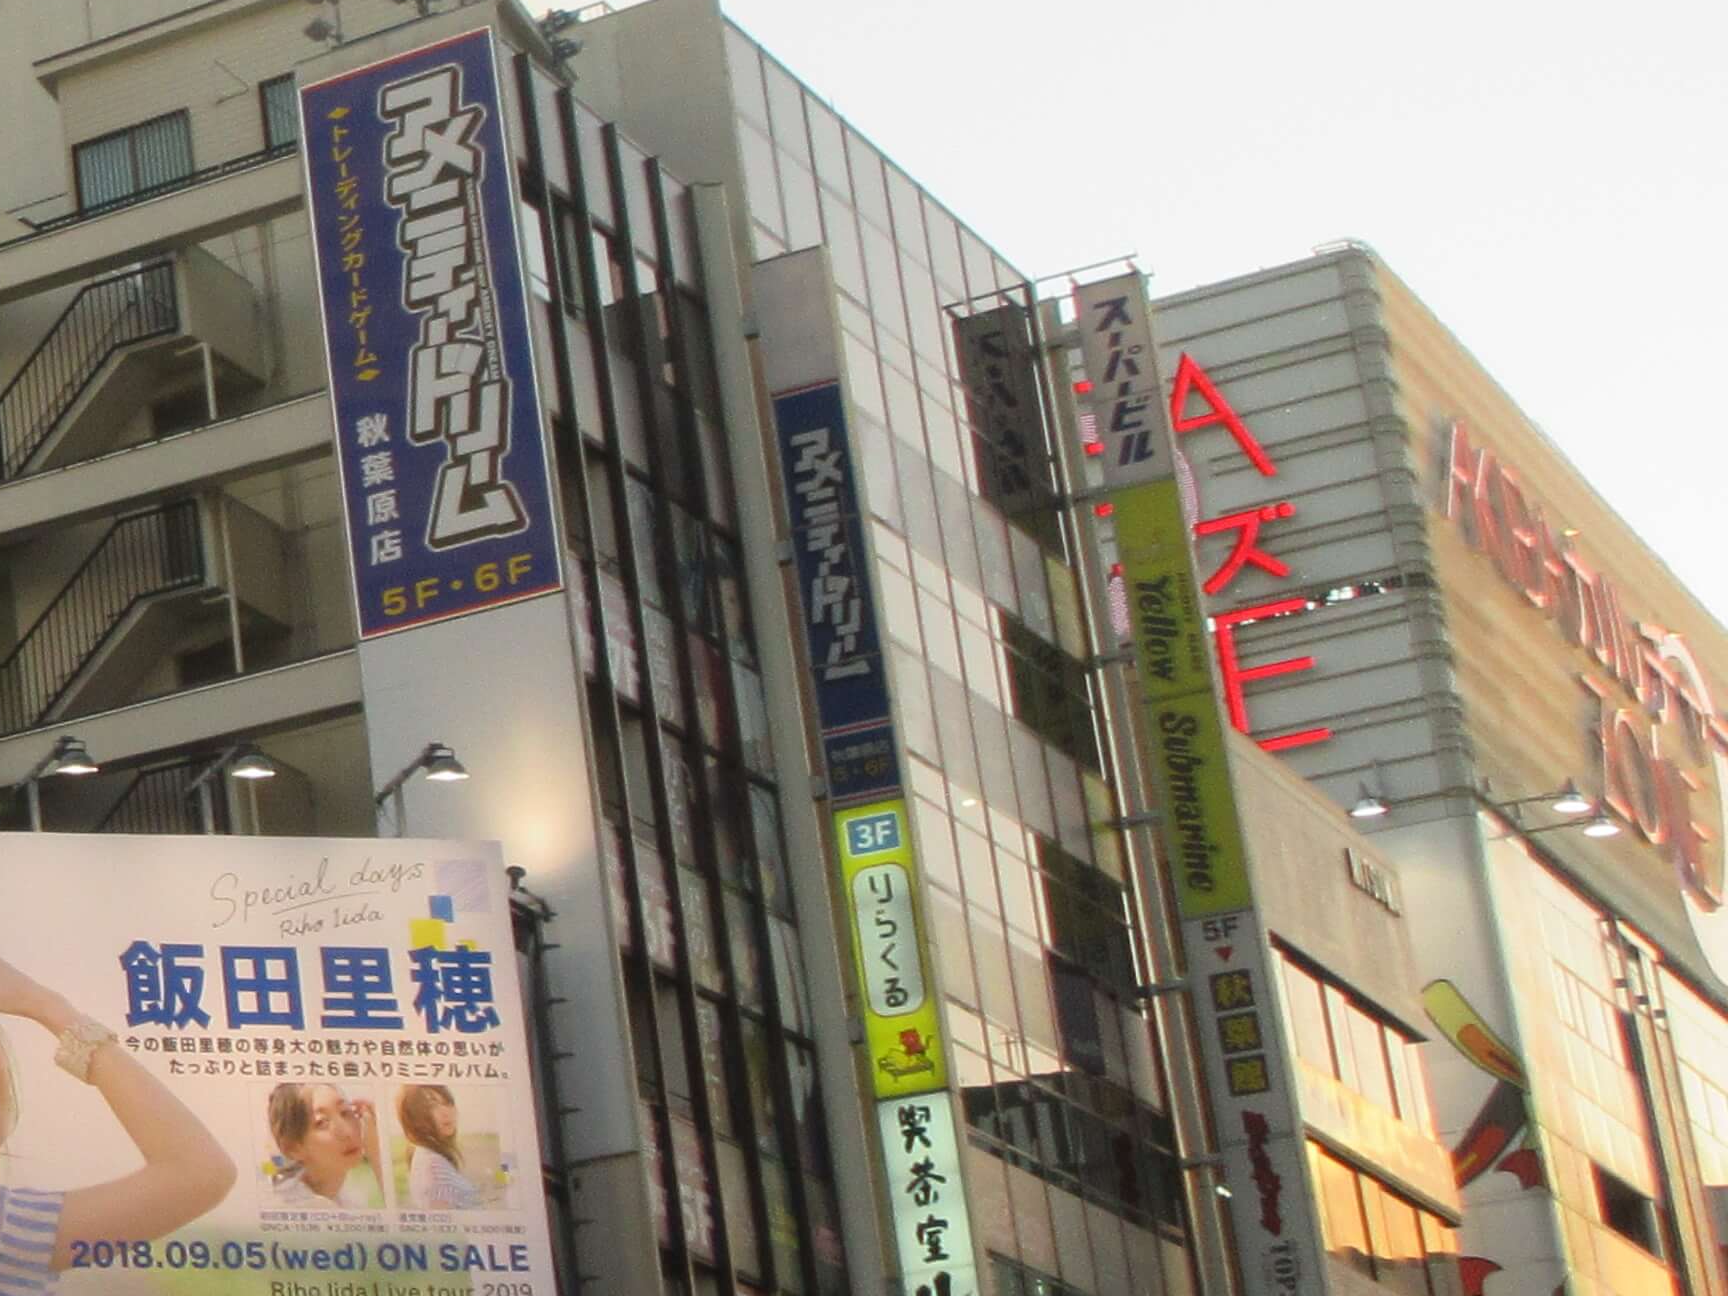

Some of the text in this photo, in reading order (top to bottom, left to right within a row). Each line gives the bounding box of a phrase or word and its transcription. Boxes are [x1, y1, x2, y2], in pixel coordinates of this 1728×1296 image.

[330, 126, 378, 366] トレーディングカードゲーム
[380, 66, 528, 552] アメニティドリーム
[1094, 296, 1154, 466] スーパービル
[357, 413, 402, 566] 秋葉原店
[855, 820, 896, 850] 3F
[1159, 710, 1217, 893] Submarine
[210, 856, 334, 929] Special
[279, 916, 324, 940] Riho
[868, 871, 908, 1009] りらくる
[119, 938, 501, 1035] 飯田里穂
[124, 1035, 505, 1058] 今の飯田里穂の等身大の魅力や自然体の思いが
[71, 1242, 529, 1275] 2018.09.05(wed) ON SALE
